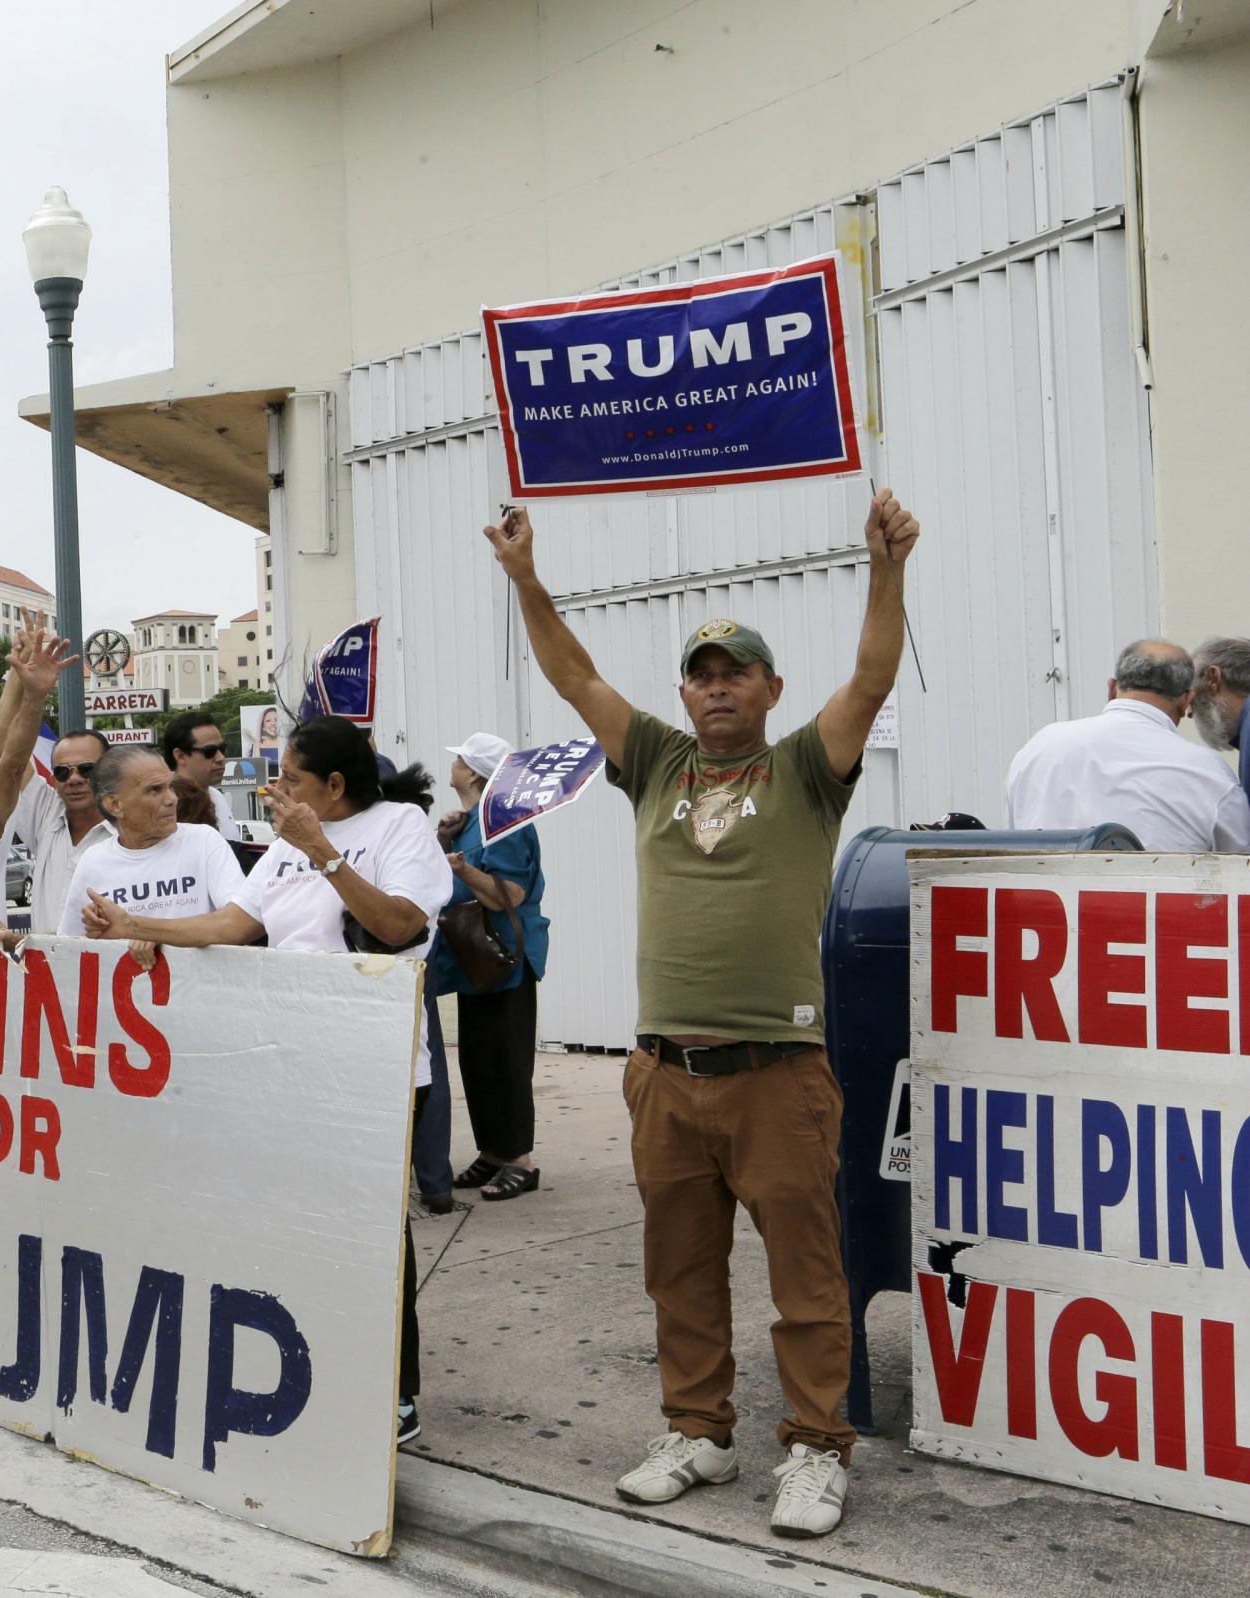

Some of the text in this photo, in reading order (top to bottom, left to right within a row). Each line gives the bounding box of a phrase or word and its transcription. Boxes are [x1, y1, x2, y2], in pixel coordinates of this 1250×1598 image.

[515, 312, 812, 386] TRUMP
[524, 370, 818, 421] MAKE AMERICA GREAT AGAIN!
[601, 443, 749, 465] www.DonaldJTrump.com
[108, 732, 149, 742] URANT
[931, 886, 1250, 1056] FREE
[890, 1146, 911, 1158] UN
